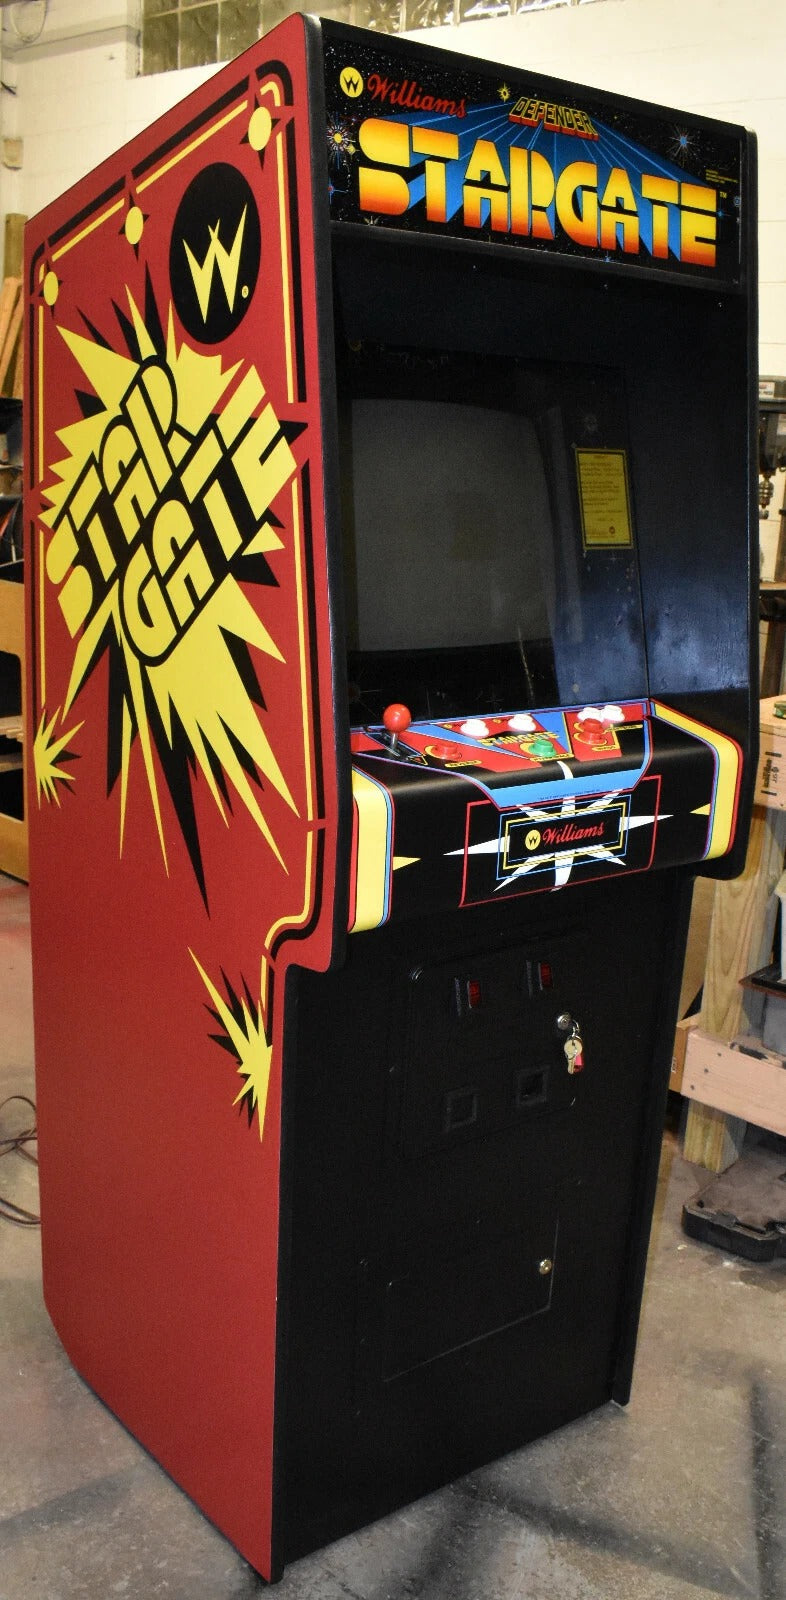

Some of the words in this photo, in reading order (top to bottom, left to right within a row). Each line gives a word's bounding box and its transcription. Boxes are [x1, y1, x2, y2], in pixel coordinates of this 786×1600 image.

[367, 74, 466, 118] Williams
[508, 97, 599, 142] DEFENDER
[358, 117, 717, 268] STARGATE
[542, 822, 604, 846] Williams
